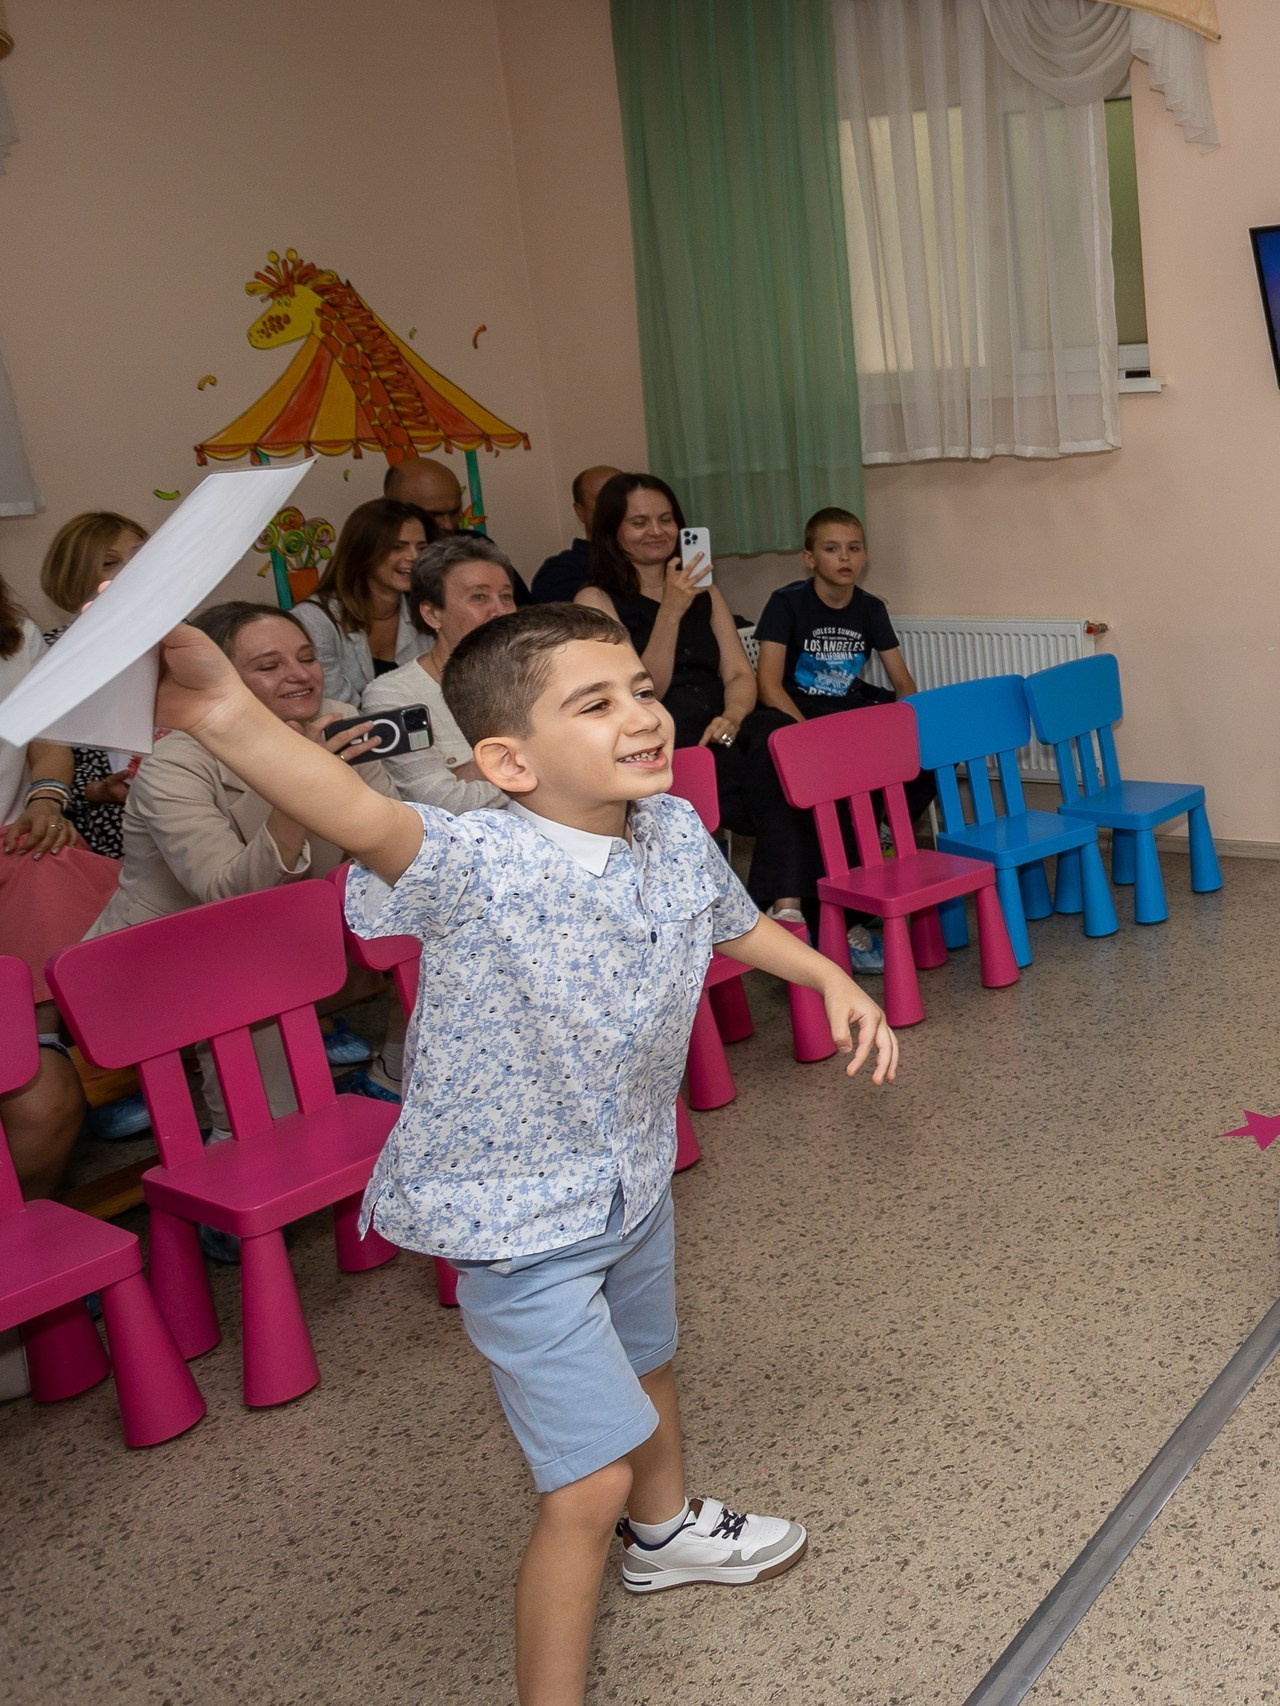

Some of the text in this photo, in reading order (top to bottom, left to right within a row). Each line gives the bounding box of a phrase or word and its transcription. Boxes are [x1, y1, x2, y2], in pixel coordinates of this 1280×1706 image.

[837, 627, 862, 640] SUMMER
[804, 639, 865, 652] LOS ANGELES
[815, 652, 853, 660] CALIFORNIA
